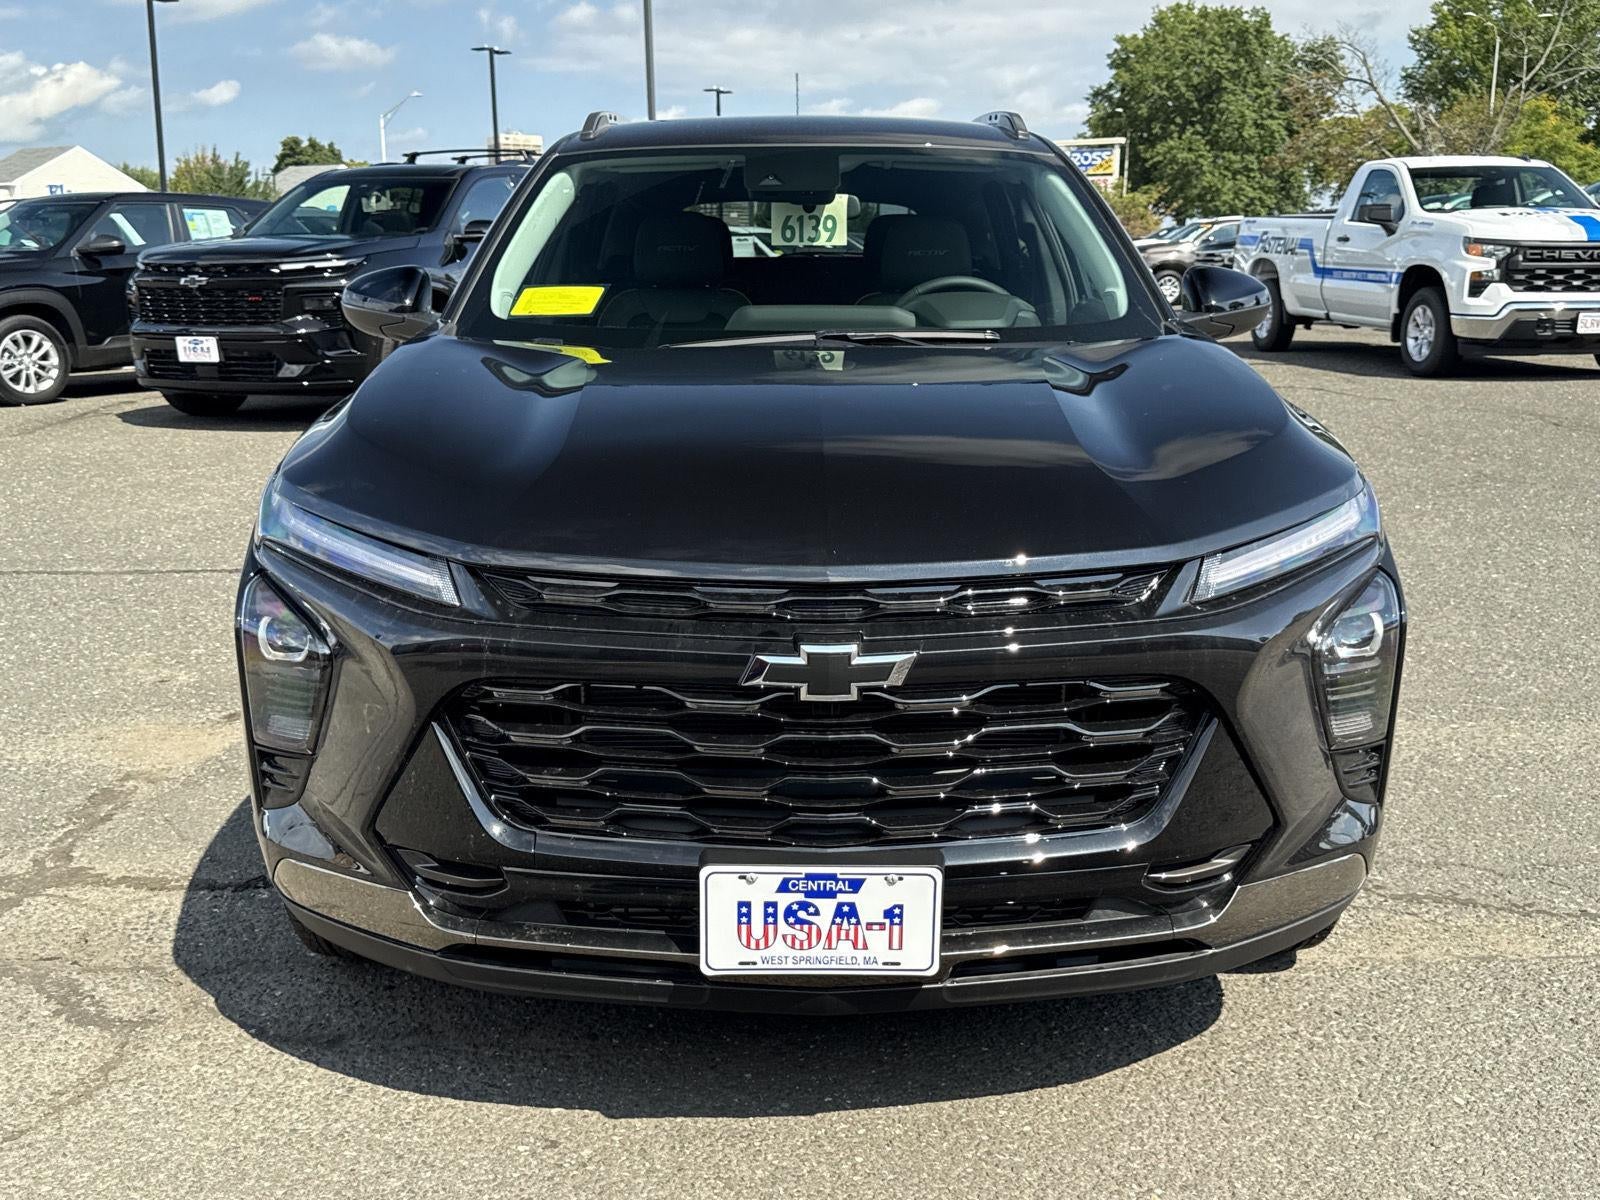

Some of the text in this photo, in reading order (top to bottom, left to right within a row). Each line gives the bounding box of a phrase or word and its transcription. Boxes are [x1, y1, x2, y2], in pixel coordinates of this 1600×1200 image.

[780, 214, 838, 243] 6139
[788, 879, 854, 892] CENTRAL
[736, 900, 904, 951] USA-1
[760, 955, 879, 967] WEST SPRINGFIELD, MA
